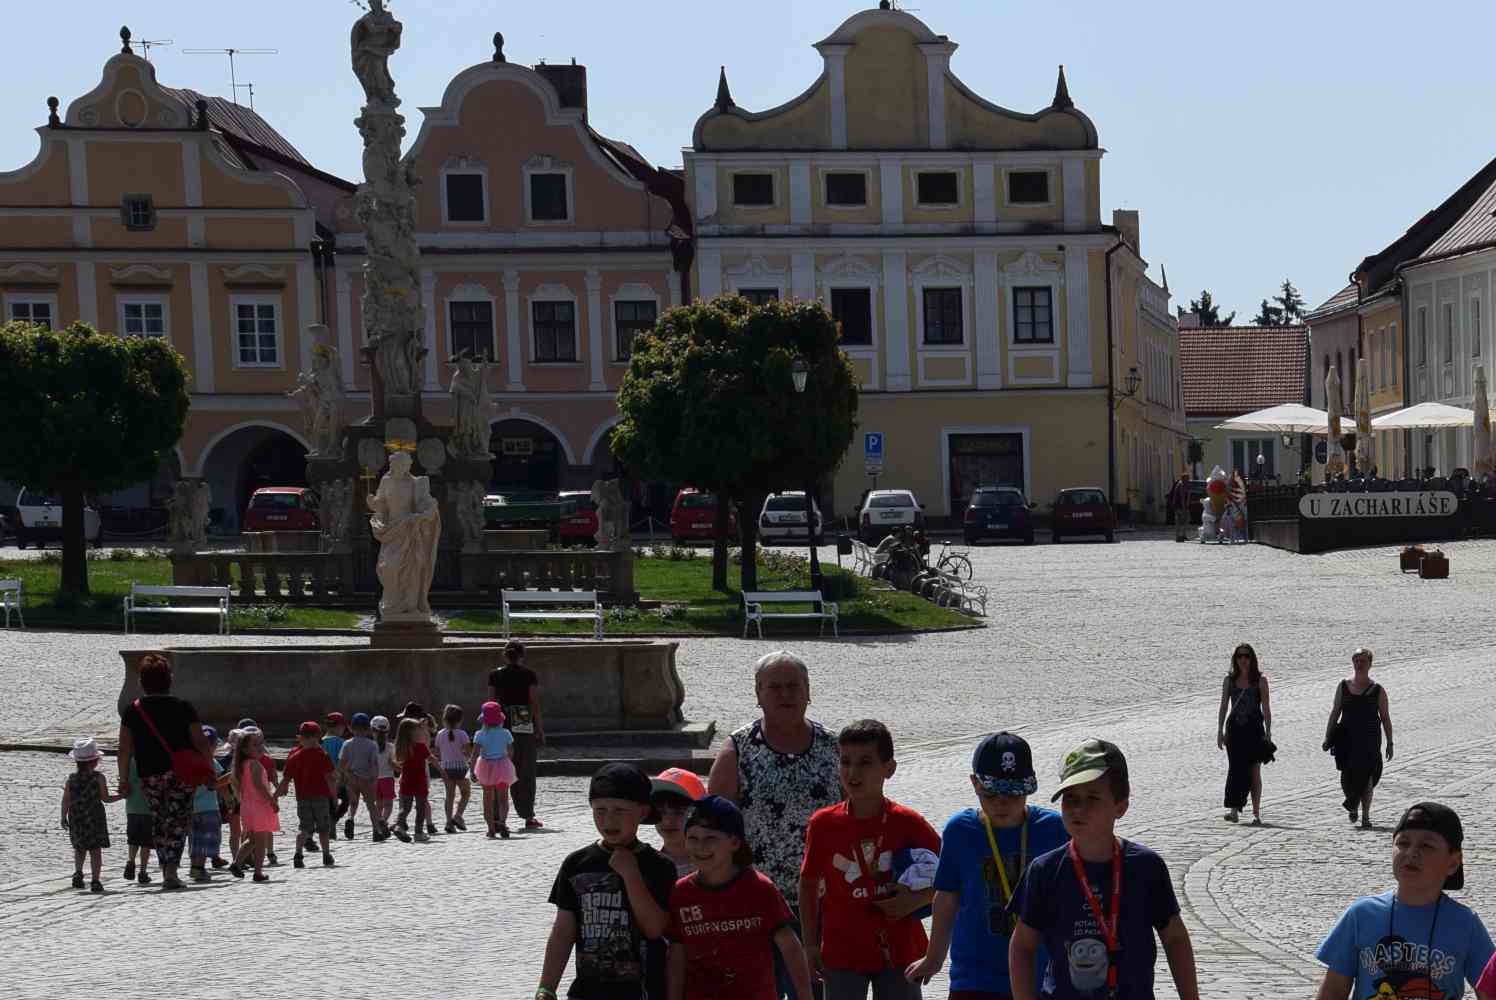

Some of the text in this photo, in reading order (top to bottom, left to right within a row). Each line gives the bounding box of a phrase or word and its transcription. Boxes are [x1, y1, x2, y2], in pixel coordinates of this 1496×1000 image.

[1310, 493, 1450, 517] U ZACHARIÁŠE
[1359, 941, 1456, 974] MASTERS
